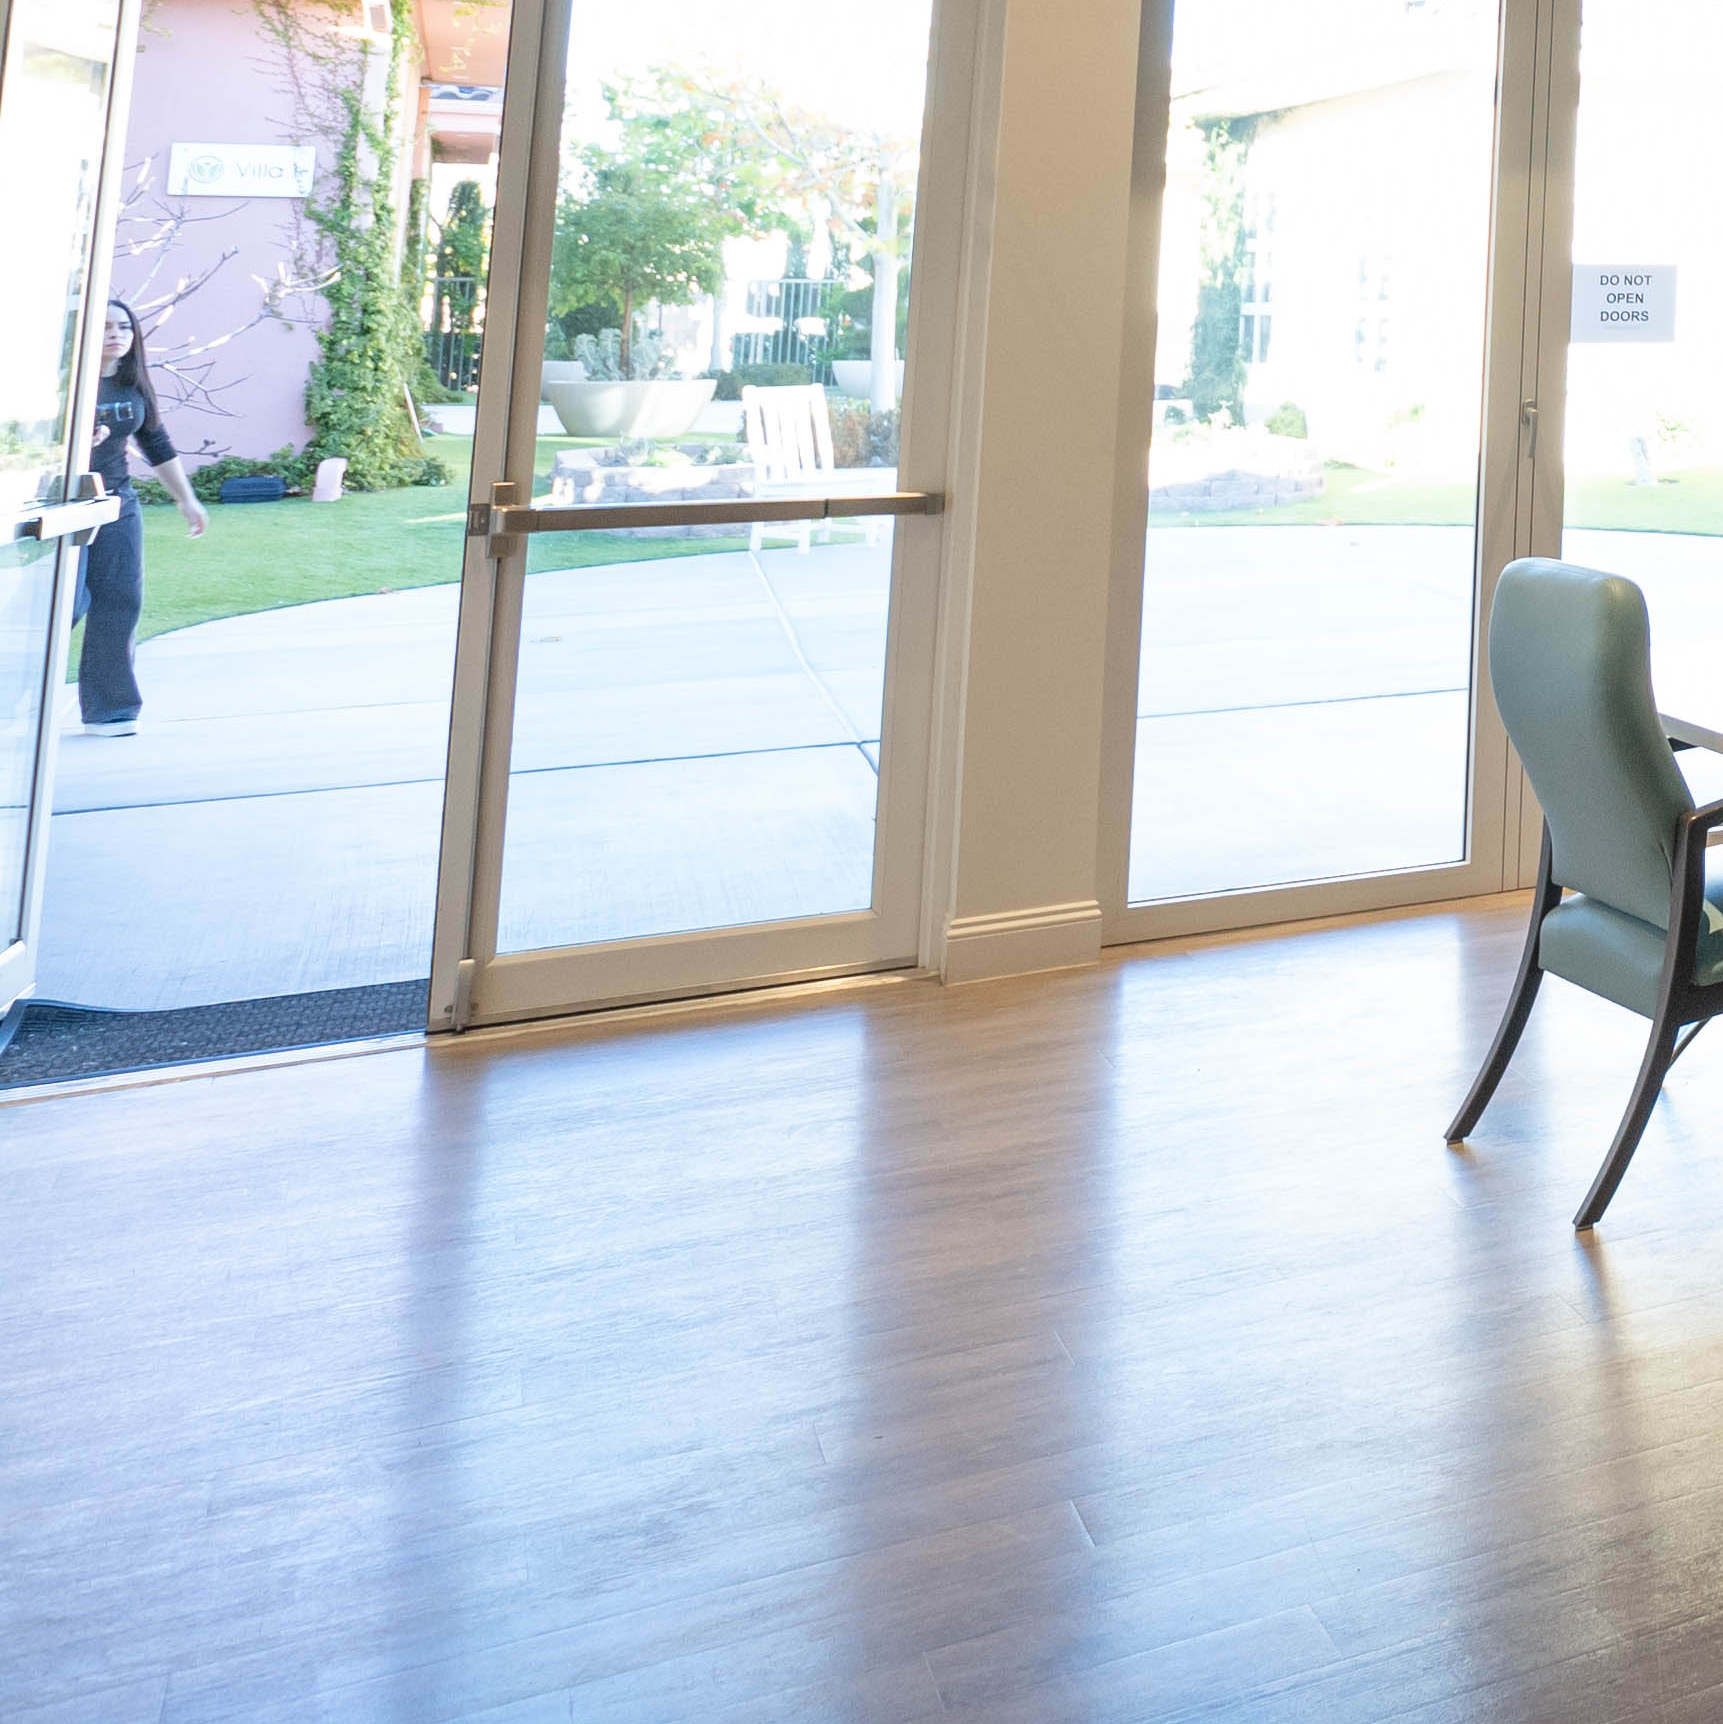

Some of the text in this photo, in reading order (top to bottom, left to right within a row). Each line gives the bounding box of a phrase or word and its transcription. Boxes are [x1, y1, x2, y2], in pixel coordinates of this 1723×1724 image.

[236, 163, 283, 179] Villa
[1600, 274, 1652, 286] DO NOT
[1606, 292, 1644, 304] OPEN
[1600, 310, 1649, 322] DOORS
